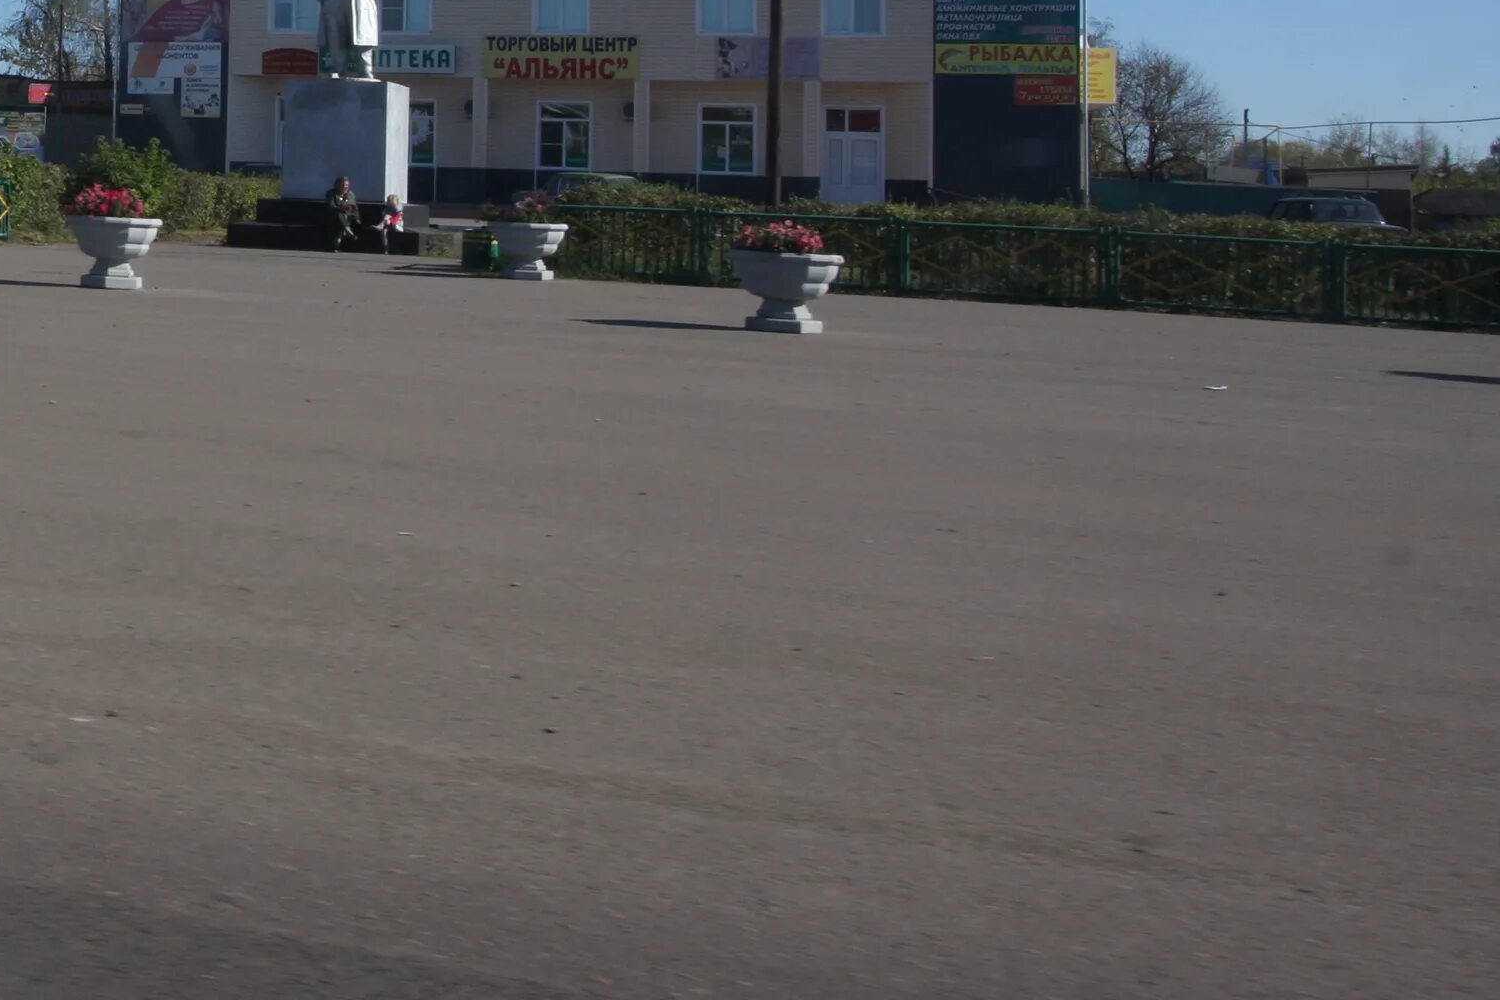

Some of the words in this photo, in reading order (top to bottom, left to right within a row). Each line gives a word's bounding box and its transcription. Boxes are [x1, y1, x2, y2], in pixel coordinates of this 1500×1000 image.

[485, 35, 577, 52] ТОРГОВЫЙ
[581, 36, 638, 54] ЦЕНТР
[968, 45, 1074, 62] РЫБАЛКА
[372, 49, 451, 68] ПТЕКА
